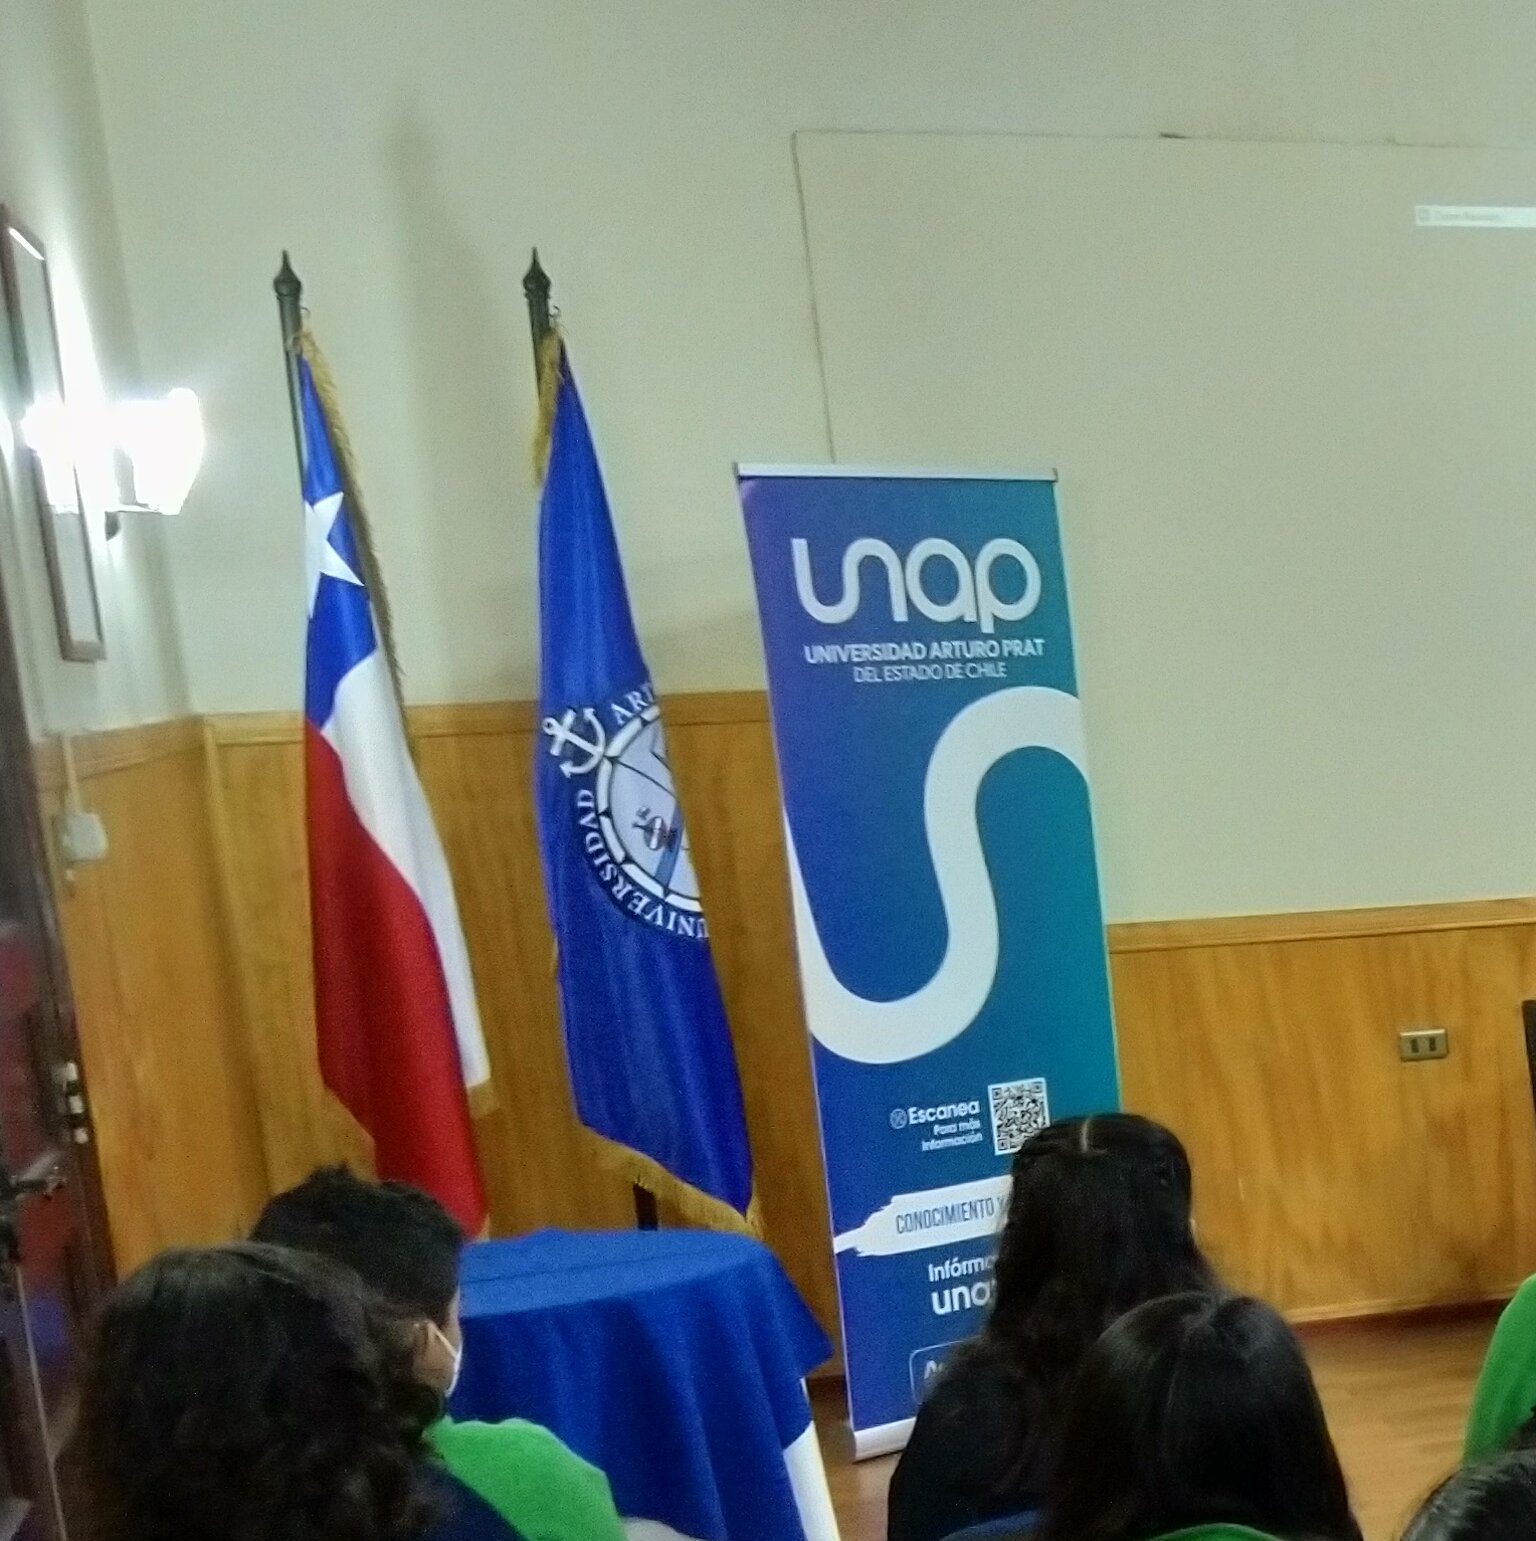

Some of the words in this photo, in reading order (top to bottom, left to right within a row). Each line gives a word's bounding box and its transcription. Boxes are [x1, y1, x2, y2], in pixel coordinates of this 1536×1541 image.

[803, 642, 928, 665] UNIVERSIDAD
[929, 640, 1001, 660] ARTURO
[1002, 638, 1046, 657] PRAT
[853, 666, 884, 683] DEL
[884, 664, 943, 681] ESTADO
[946, 663, 965, 679] DE
[965, 661, 1007, 678] CHILE
[907, 1100, 981, 1125] Escanea
[895, 1197, 995, 1235] CONOCIMIENTO
[930, 1279, 998, 1316] una
